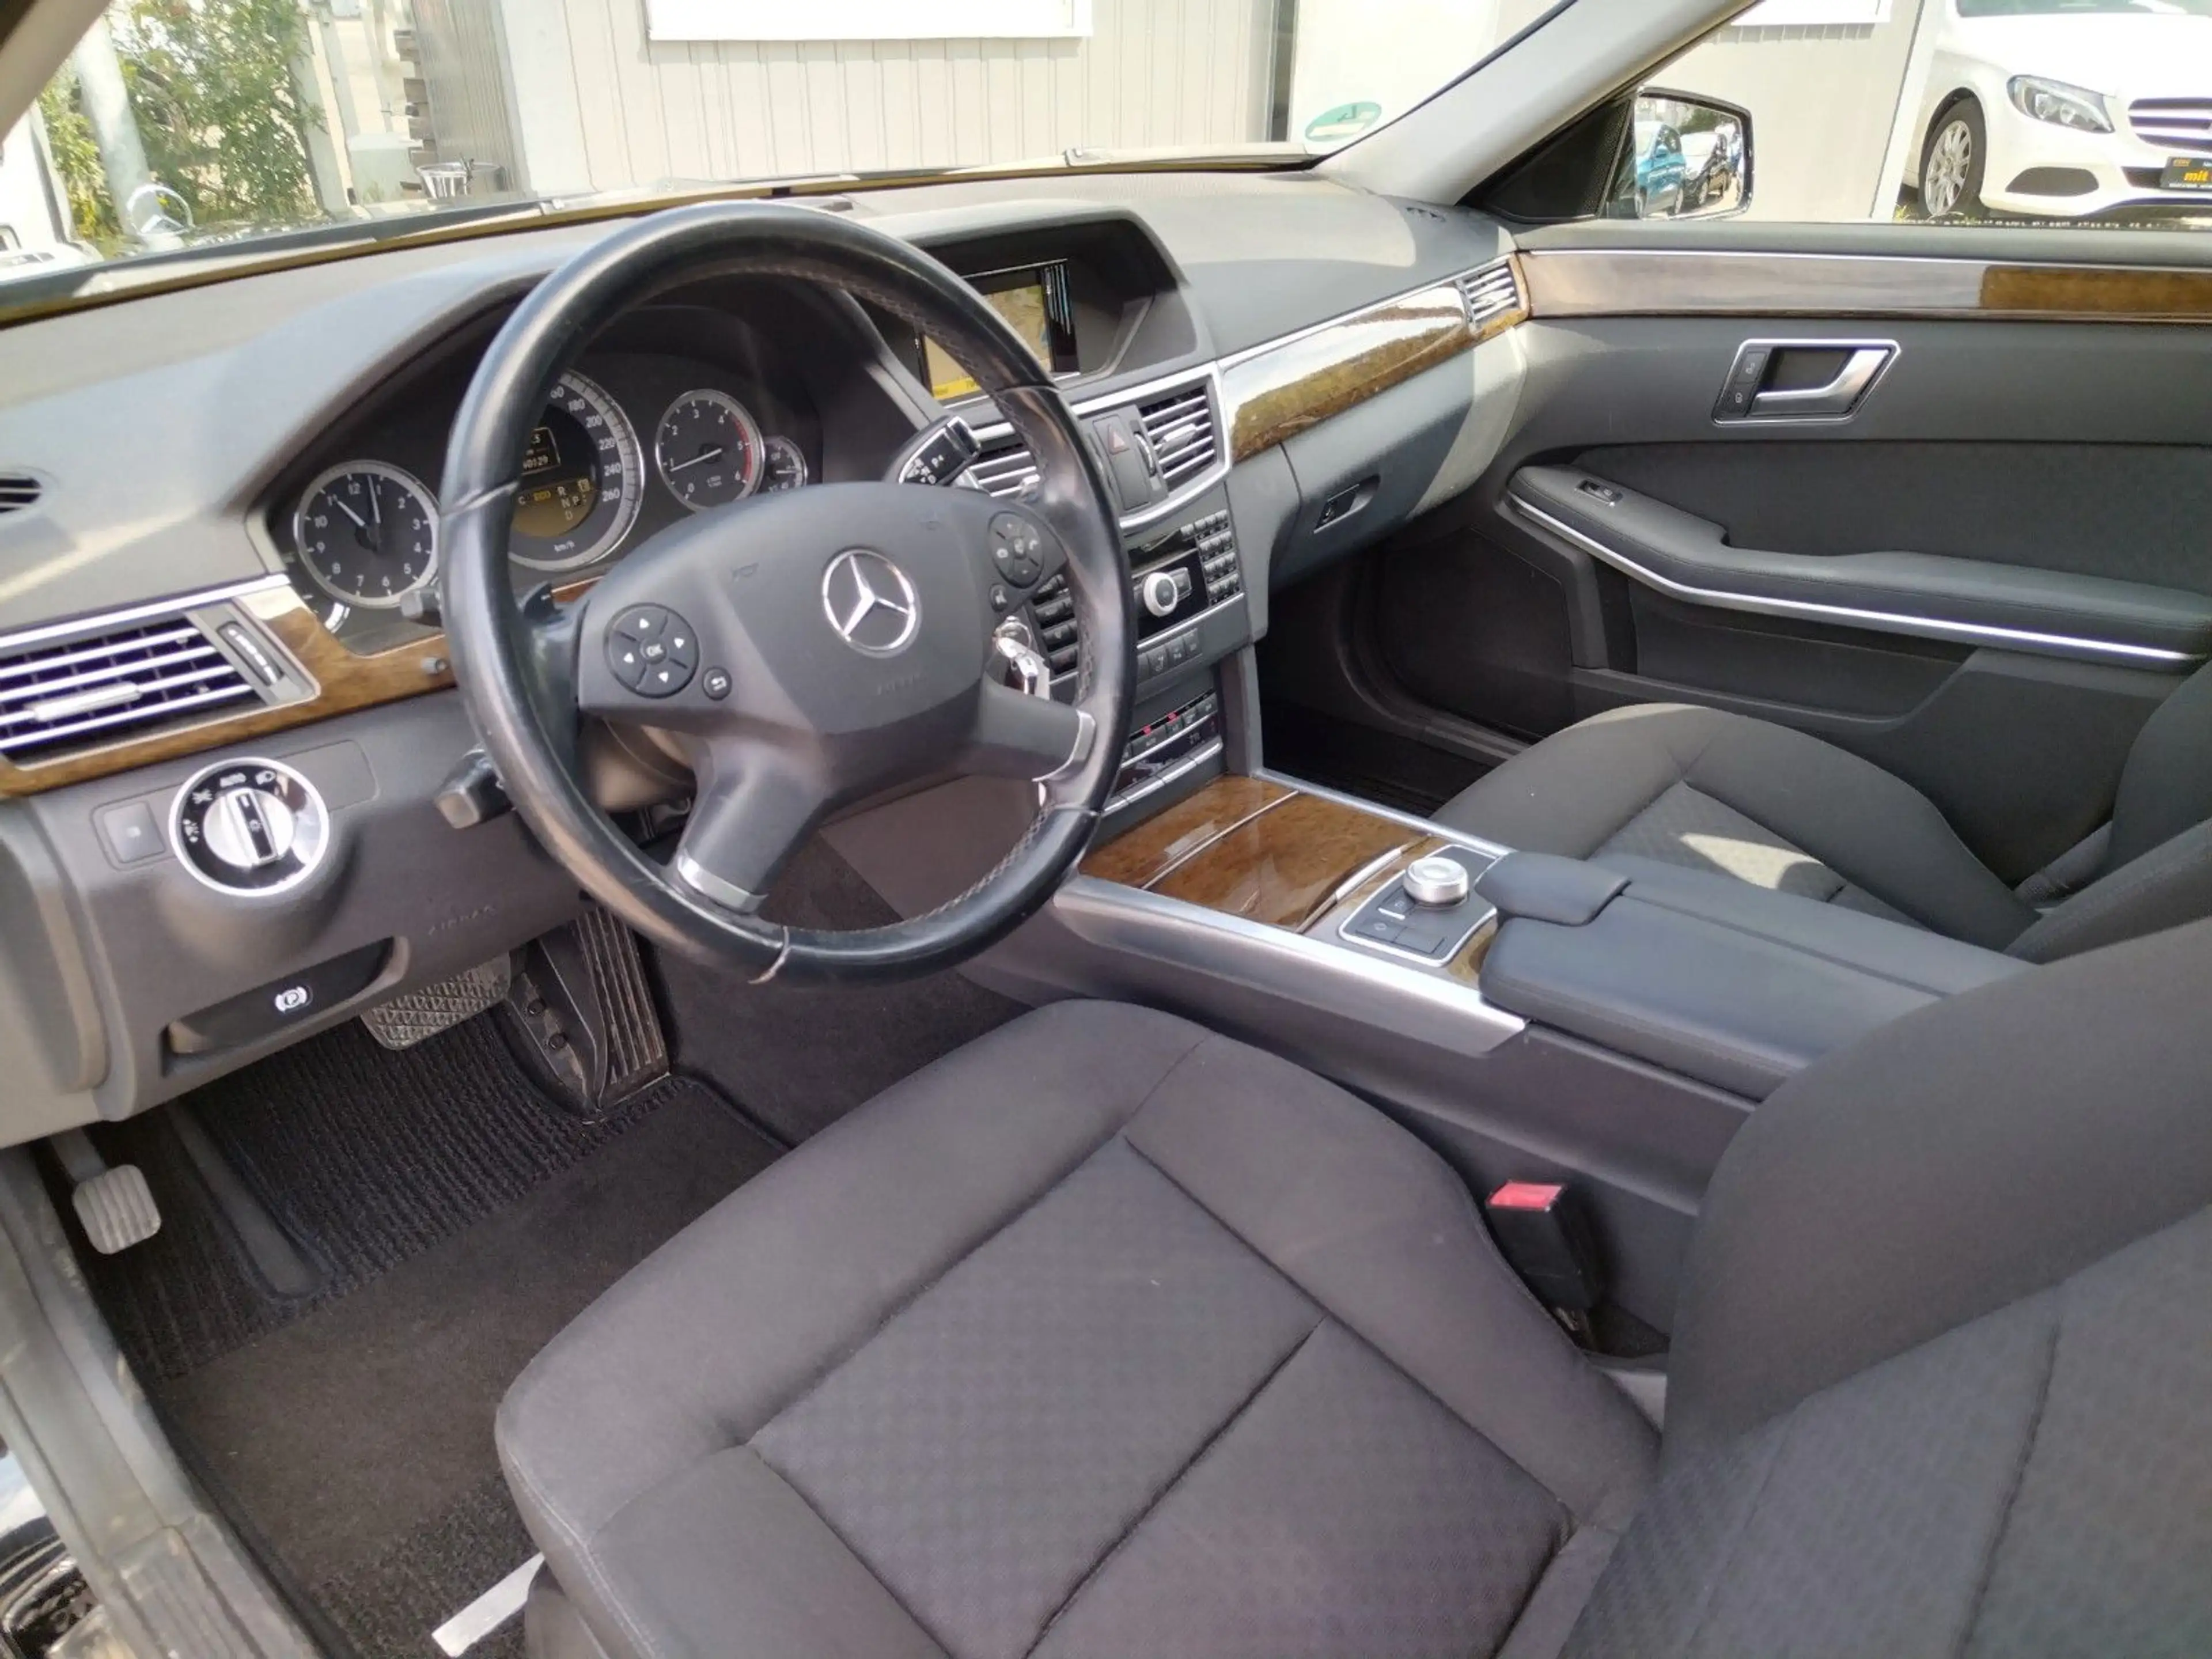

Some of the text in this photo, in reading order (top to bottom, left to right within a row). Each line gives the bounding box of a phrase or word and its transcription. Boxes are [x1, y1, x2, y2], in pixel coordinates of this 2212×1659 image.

[694, 409, 699, 419] 3
[718, 415, 725, 425] 4
[672, 425, 678, 436] 2
[598, 437, 616, 450] 220
[737, 440, 744, 451] 5
[604, 463, 621, 477] 240
[348, 483, 361, 495] 12
[603, 487, 620, 502] 260
[397, 497, 406, 510] 2
[315, 515, 328, 529] 10
[412, 518, 421, 531] 3
[316, 542, 326, 554] 9
[414, 542, 422, 554] 4
[332, 562, 341, 575] 8
[404, 563, 411, 575] 5
[357, 574, 364, 587] 7
[382, 576, 390, 588] 6
